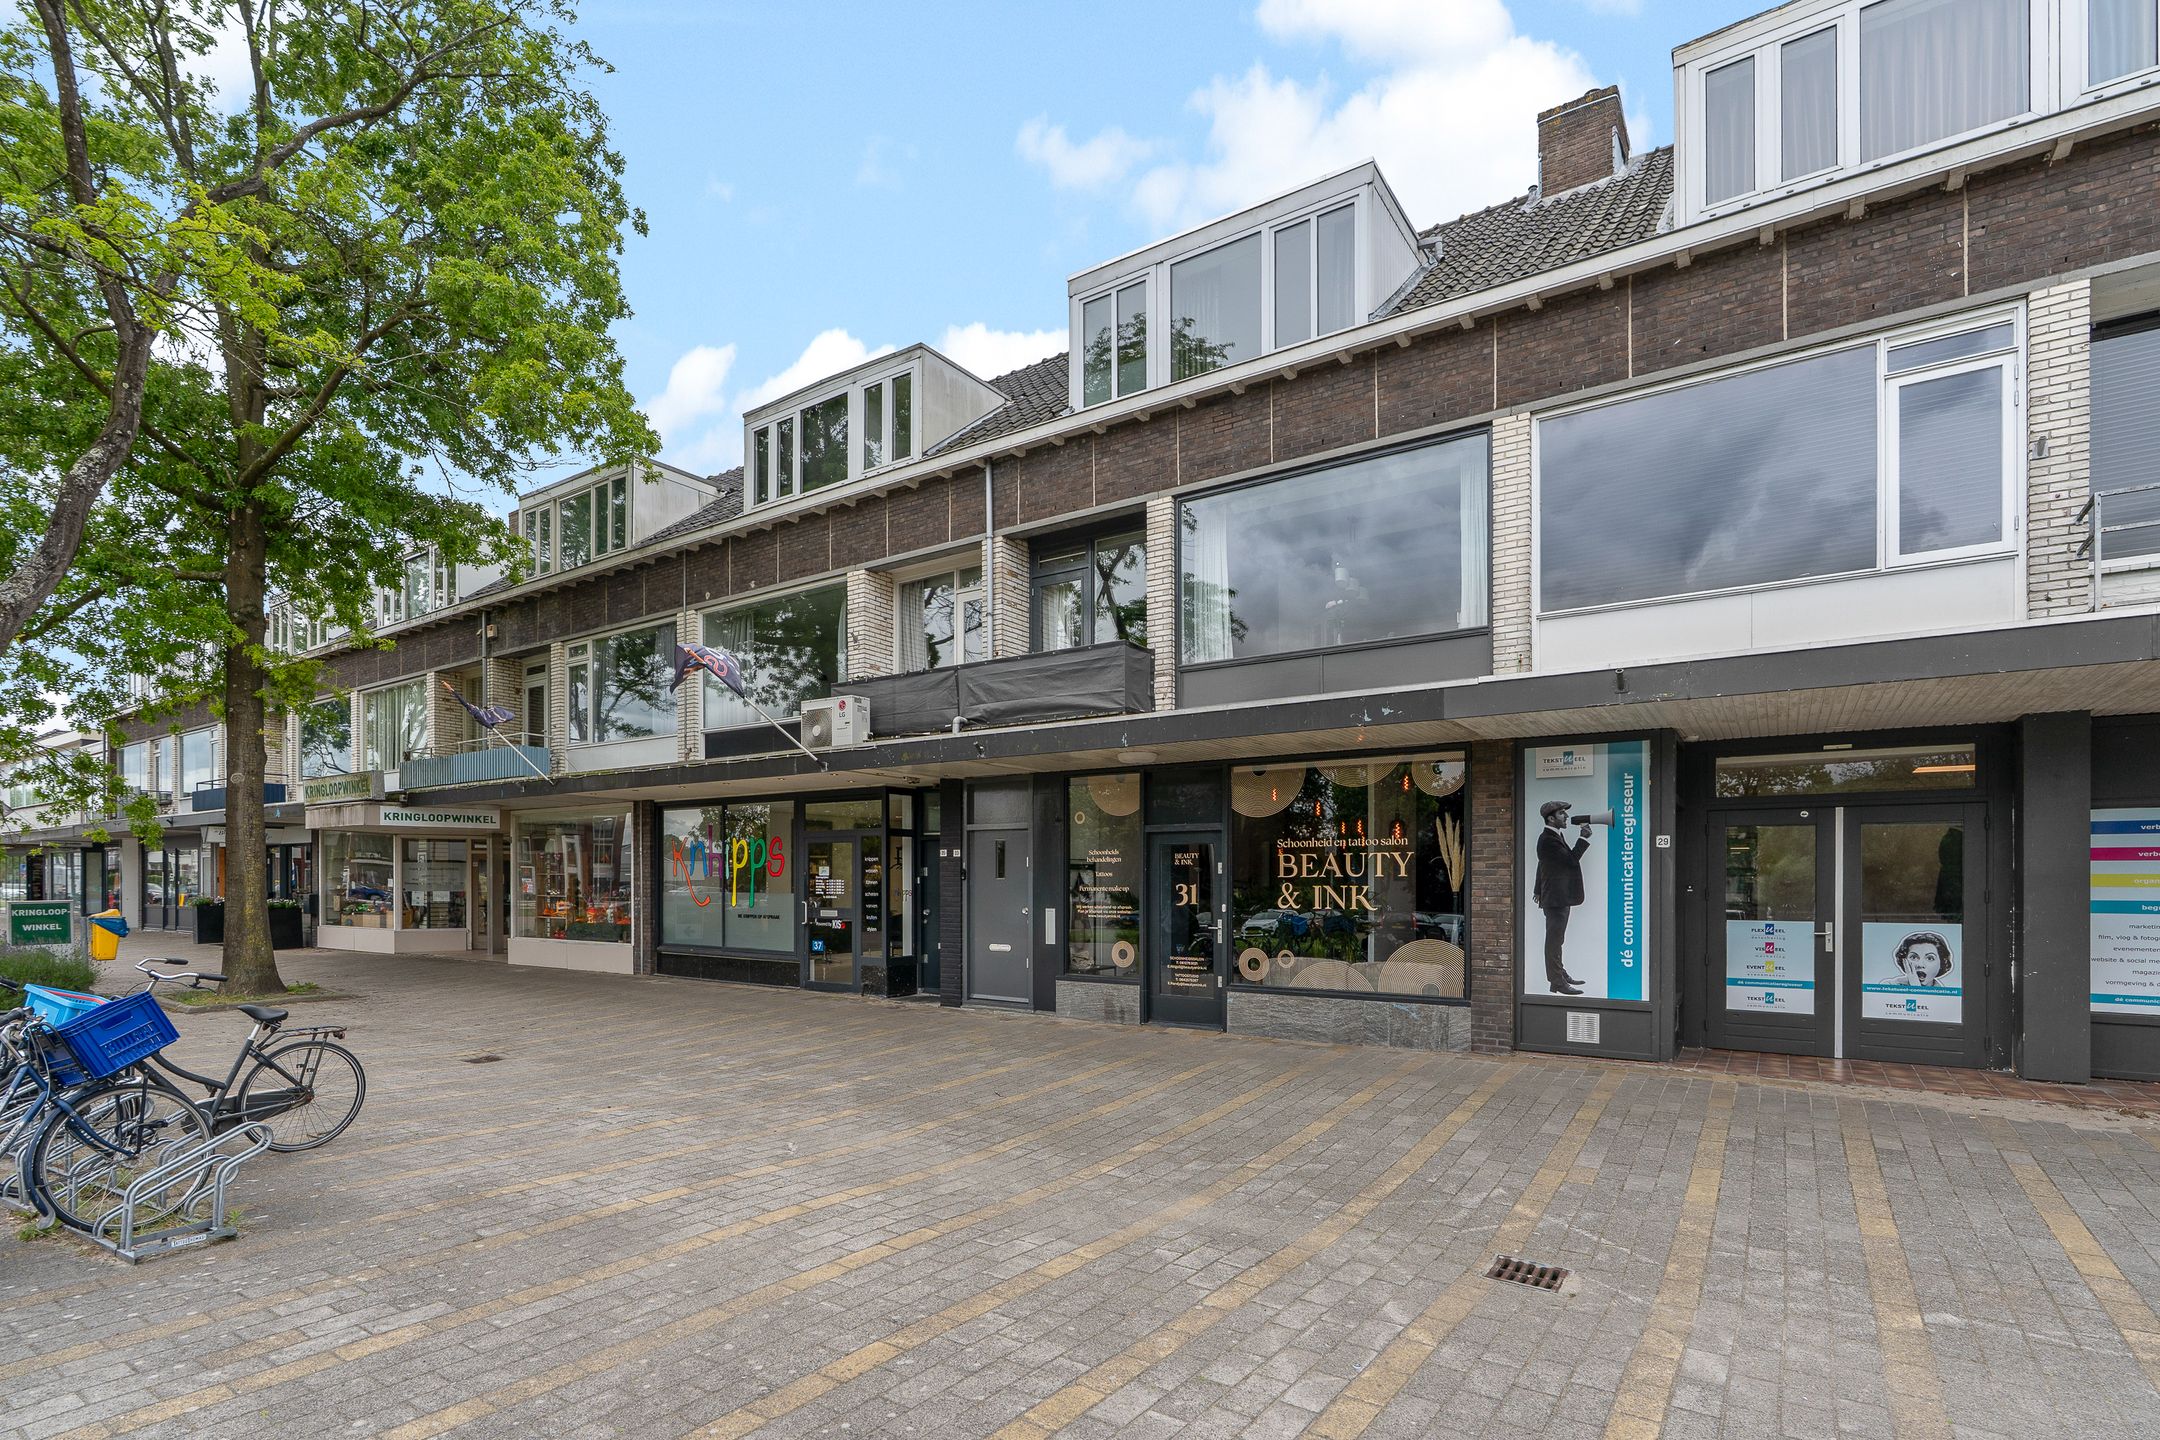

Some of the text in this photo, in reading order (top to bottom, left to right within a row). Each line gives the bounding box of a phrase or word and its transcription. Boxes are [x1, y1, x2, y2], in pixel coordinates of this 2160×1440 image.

[305, 778, 371, 799] KRINGLOOPWINKEL
[384, 812, 497, 825] KRINGLOOPWINKEL
[1276, 837, 1408, 848] Schoonheid en tattoo salon
[1657, 837, 1669, 846] 29
[1277, 851, 1415, 878] BEAUTY
[1621, 773, 1636, 968] dé communicatieregisseur
[1175, 883, 1198, 906] 31
[1277, 882, 1378, 911] & INK
[22, 923, 62, 931] WINKEL
[813, 942, 821, 950] 37
